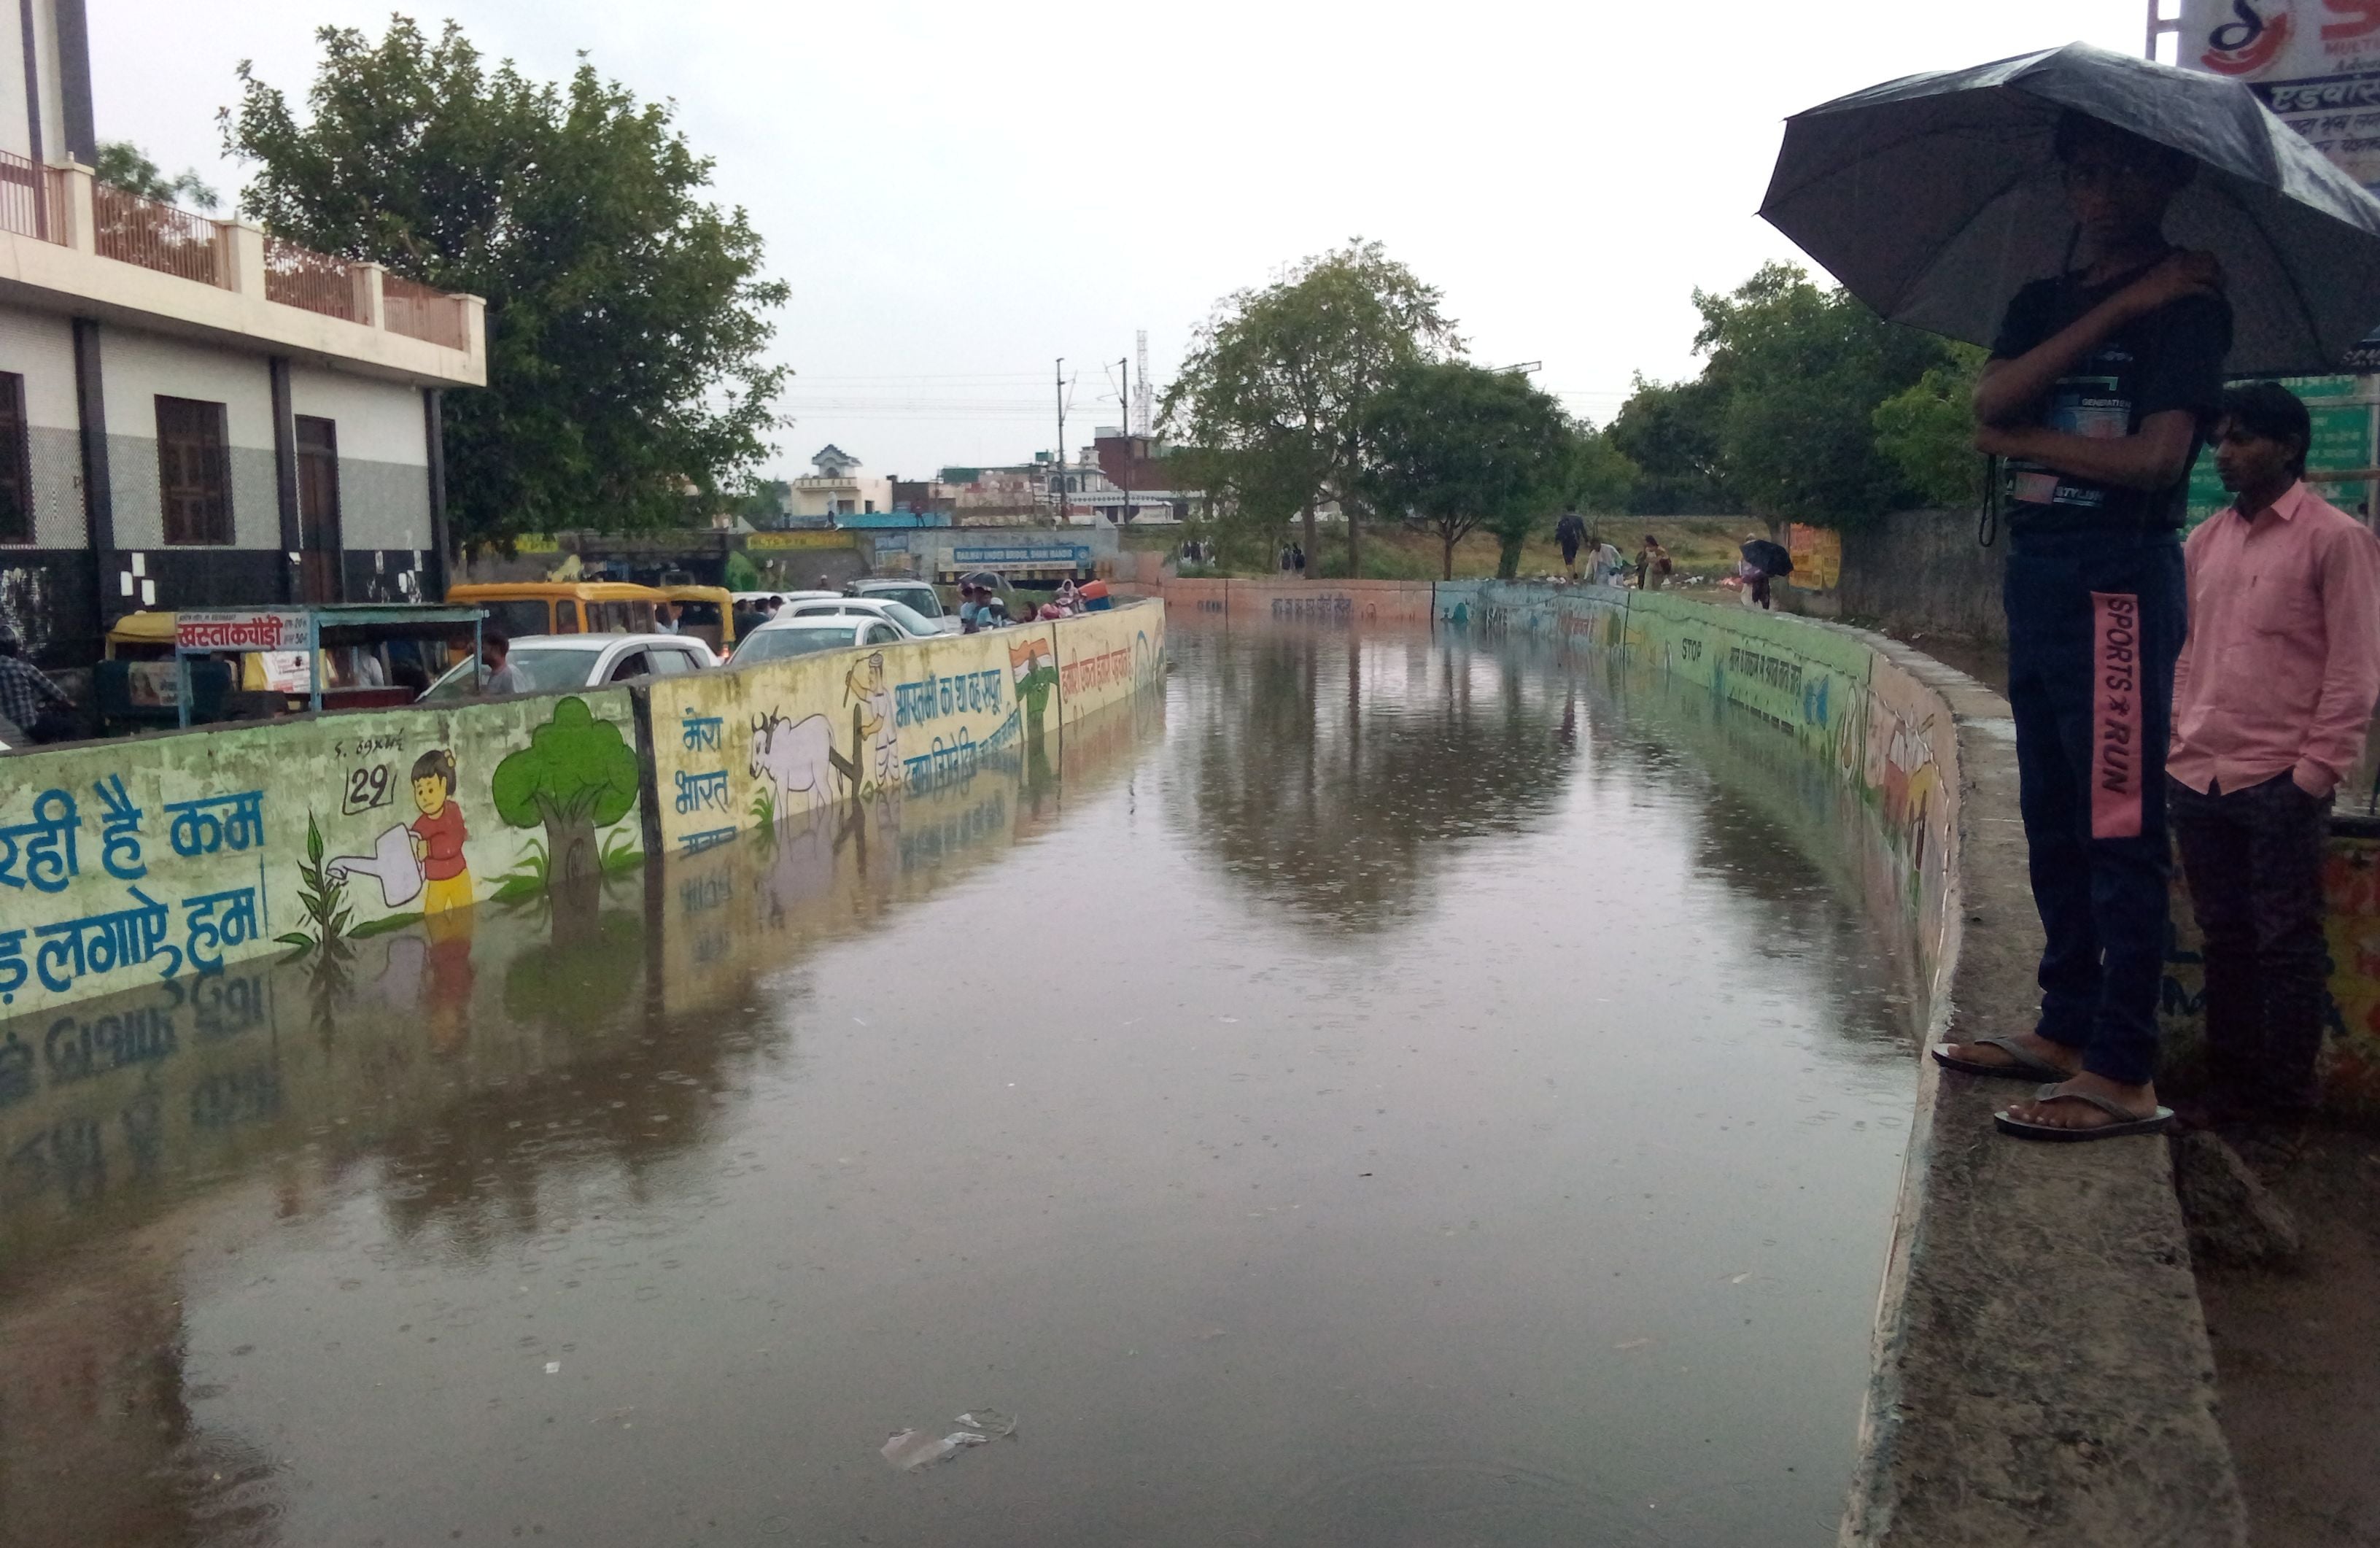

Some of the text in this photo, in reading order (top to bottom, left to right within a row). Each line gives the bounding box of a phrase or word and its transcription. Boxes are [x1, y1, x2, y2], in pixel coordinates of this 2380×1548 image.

[1681, 637, 1702, 662] STOP
[2101, 597, 2134, 794] SPORTS RUN
[682, 707, 724, 752] मेरा
[350, 763, 388, 806] 29
[675, 770, 729, 814] भारत
[93, 773, 148, 881] है
[163, 790, 264, 857] कम
[181, 887, 260, 976] हम
